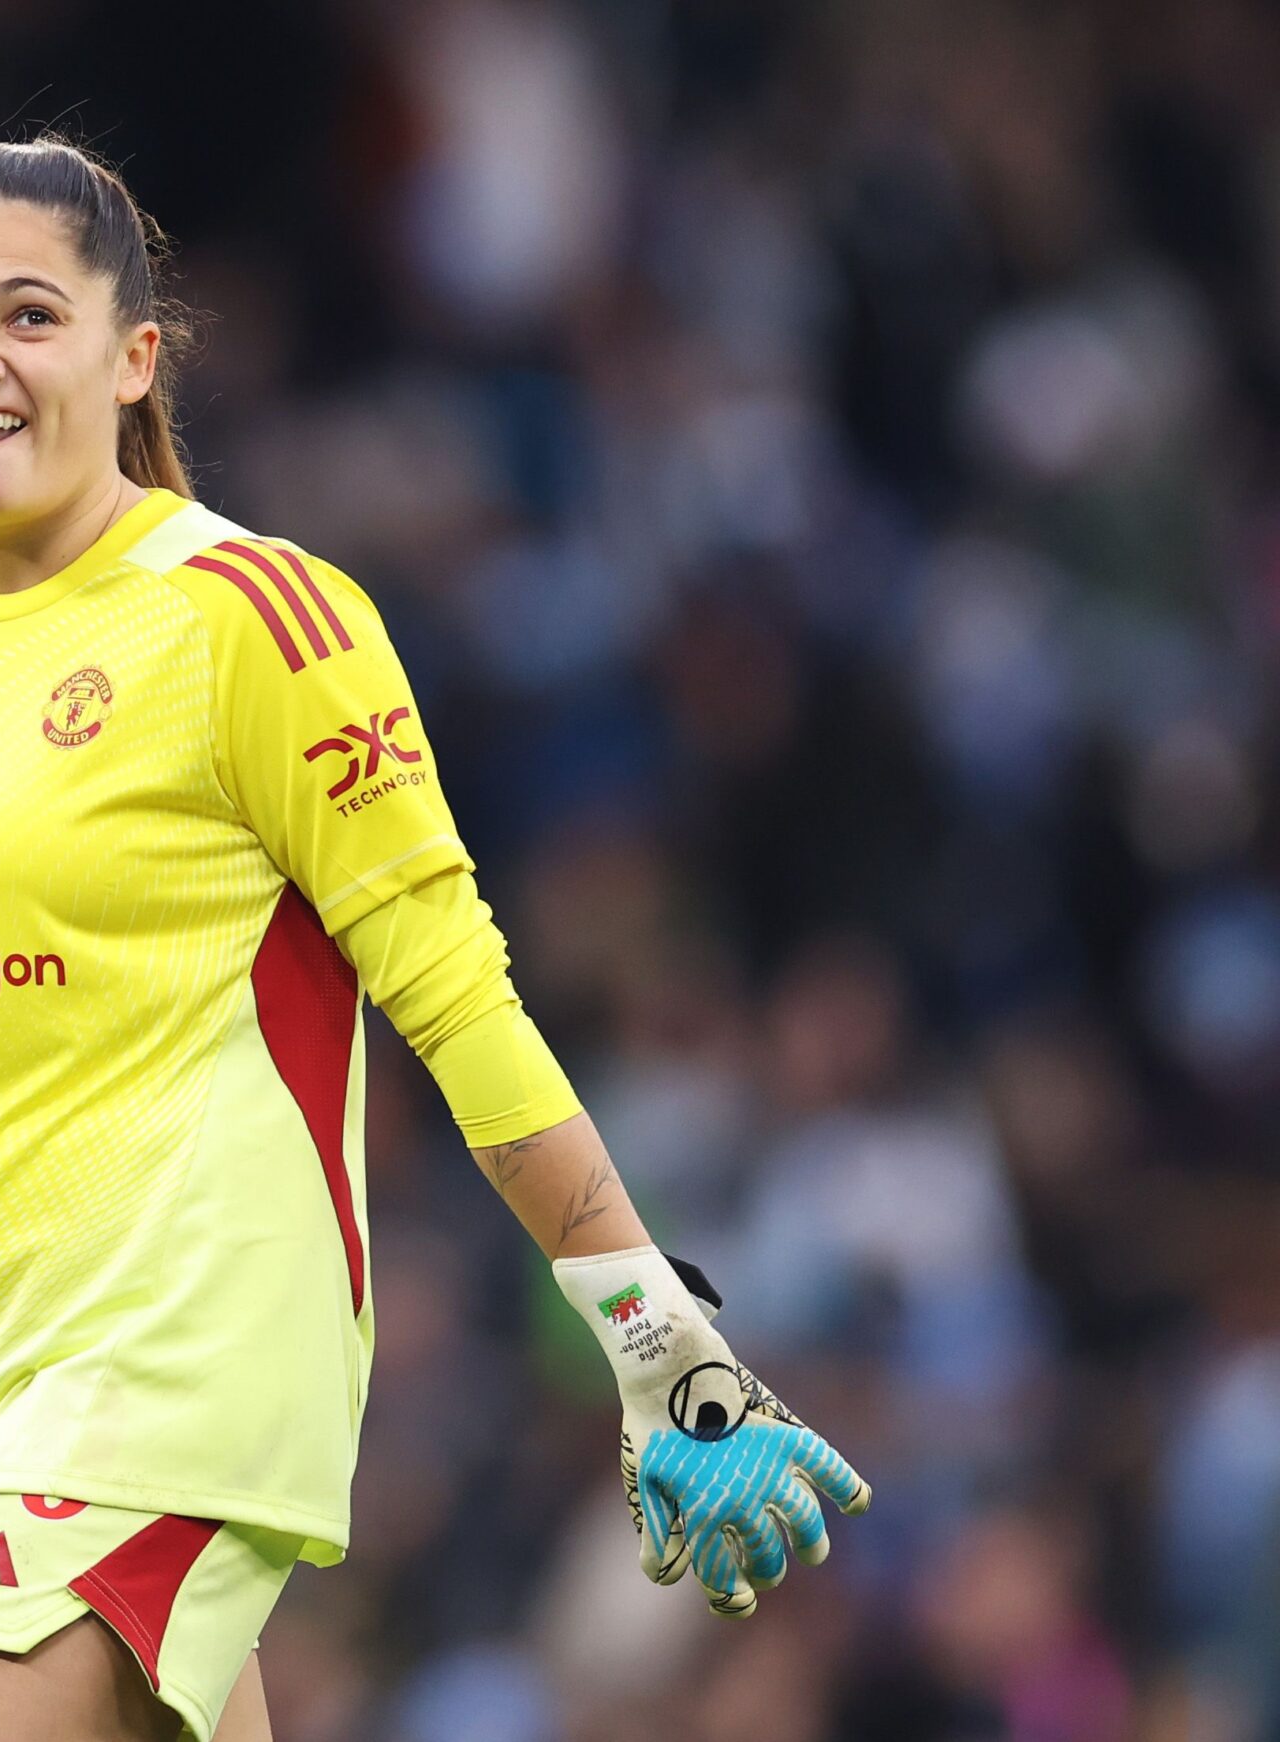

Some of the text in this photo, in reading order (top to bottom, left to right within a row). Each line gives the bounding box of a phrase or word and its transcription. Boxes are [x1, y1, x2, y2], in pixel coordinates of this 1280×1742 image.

[55, 670, 111, 701] MANCHESTER
[47, 728, 90, 745] UNITED
[336, 770, 426, 818] TECHNOGY
[624, 1318, 652, 1341] Patel
[638, 1342, 667, 1361] Safia
